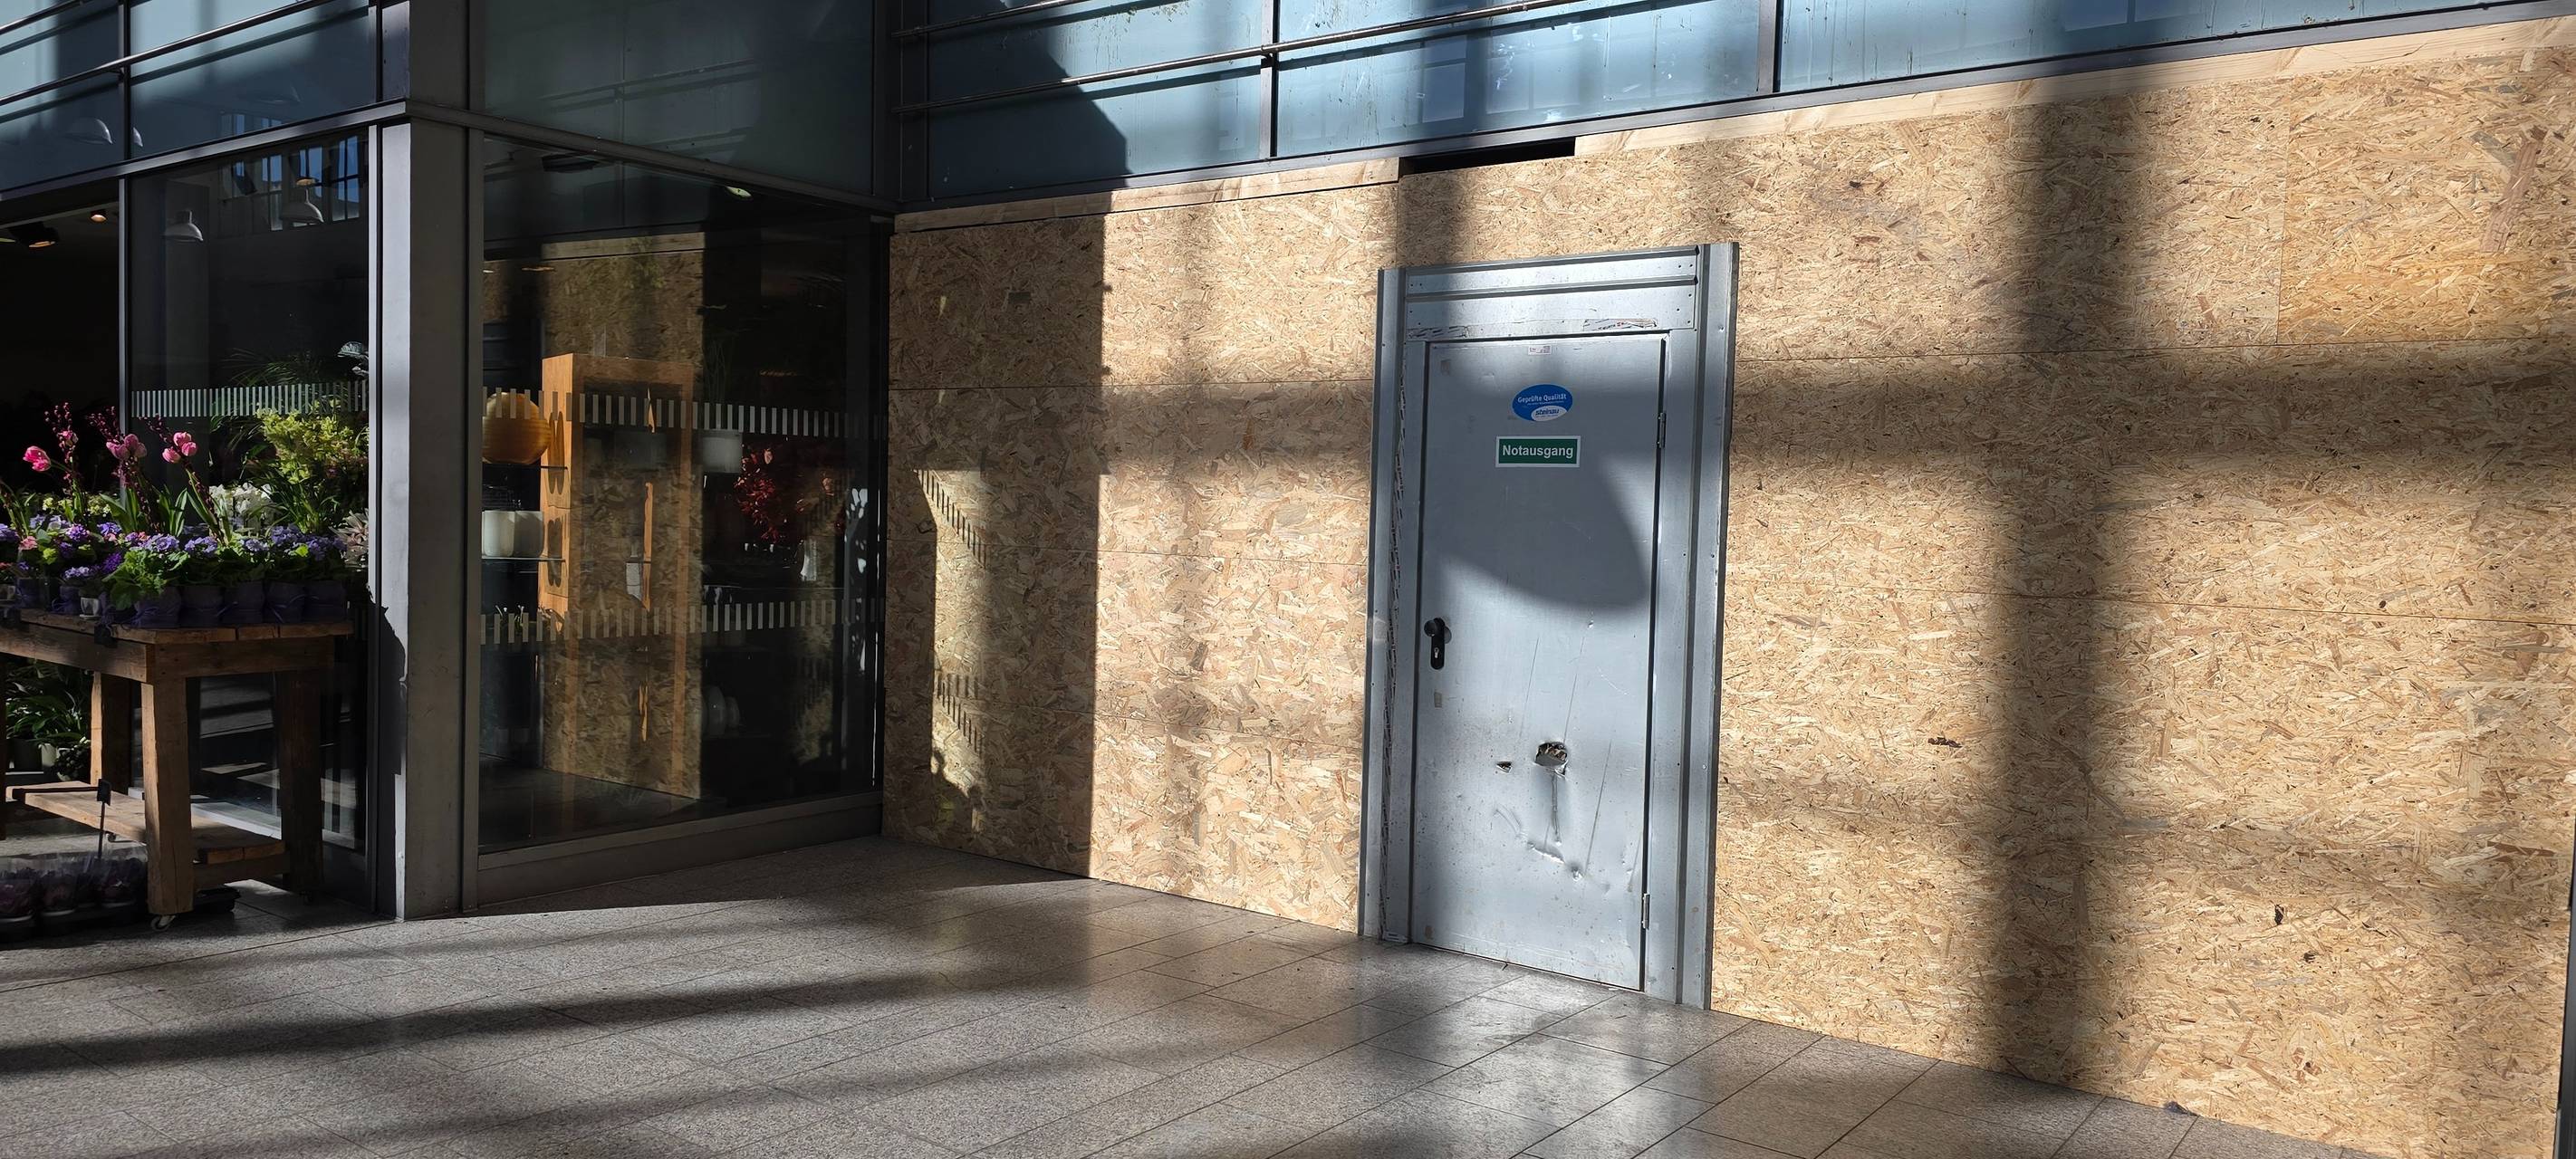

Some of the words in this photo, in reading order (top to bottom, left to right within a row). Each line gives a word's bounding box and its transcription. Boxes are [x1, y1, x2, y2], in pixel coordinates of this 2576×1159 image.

[1517, 395, 1542, 403] Geprüfte
[1543, 393, 1567, 401] Qualität
[1503, 445, 1573, 458] Notausgang
